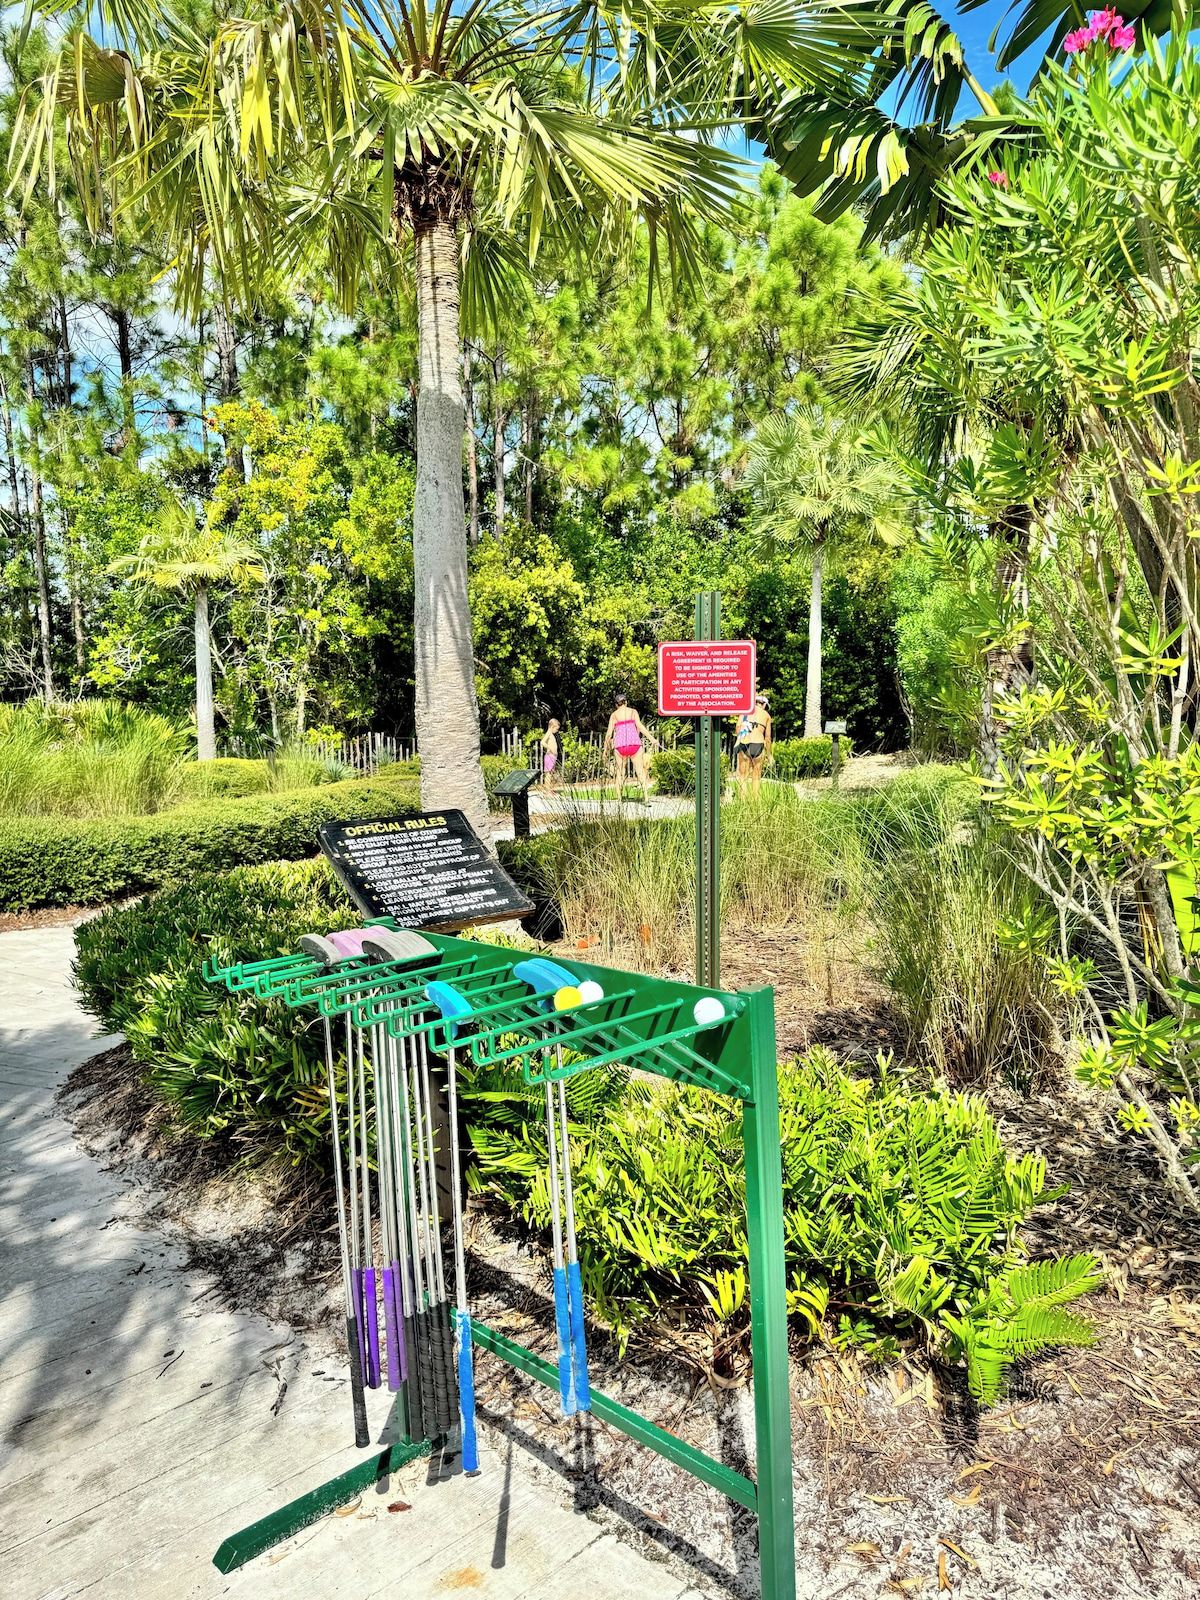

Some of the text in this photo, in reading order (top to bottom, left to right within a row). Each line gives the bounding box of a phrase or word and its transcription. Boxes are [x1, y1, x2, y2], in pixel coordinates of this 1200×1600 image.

[346, 816, 447, 836] OFFICIAL RULES
[357, 833, 408, 843] CONSIDERATE
[356, 855, 386, 864] PLEASE
[360, 861, 386, 869] GROUP
[388, 857, 413, 865] AHEAD
[430, 851, 462, 859] FINISHED
[364, 867, 393, 876] PLEASE
[368, 868, 426, 880] OTHER GROUPS
[393, 876, 418, 884] BALLS
[418, 870, 457, 880] REPLACED
[376, 881, 423, 892] CLUBHOUSE
[435, 875, 463, 883] STROKE
[463, 869, 493, 878] PENALTY
[398, 887, 428, 896] STROKE
[429, 882, 461, 890] PENALTY
[437, 894, 464, 903] MOVED
[469, 888, 496, 897] INCHES
[383, 890, 447, 905] LEAVES FAIRWAY
[391, 908, 415, 916] FROM
[452, 896, 483, 905] PENALTY
[418, 908, 454, 919] NEAREST
[470, 901, 494, 910] PUTTS
